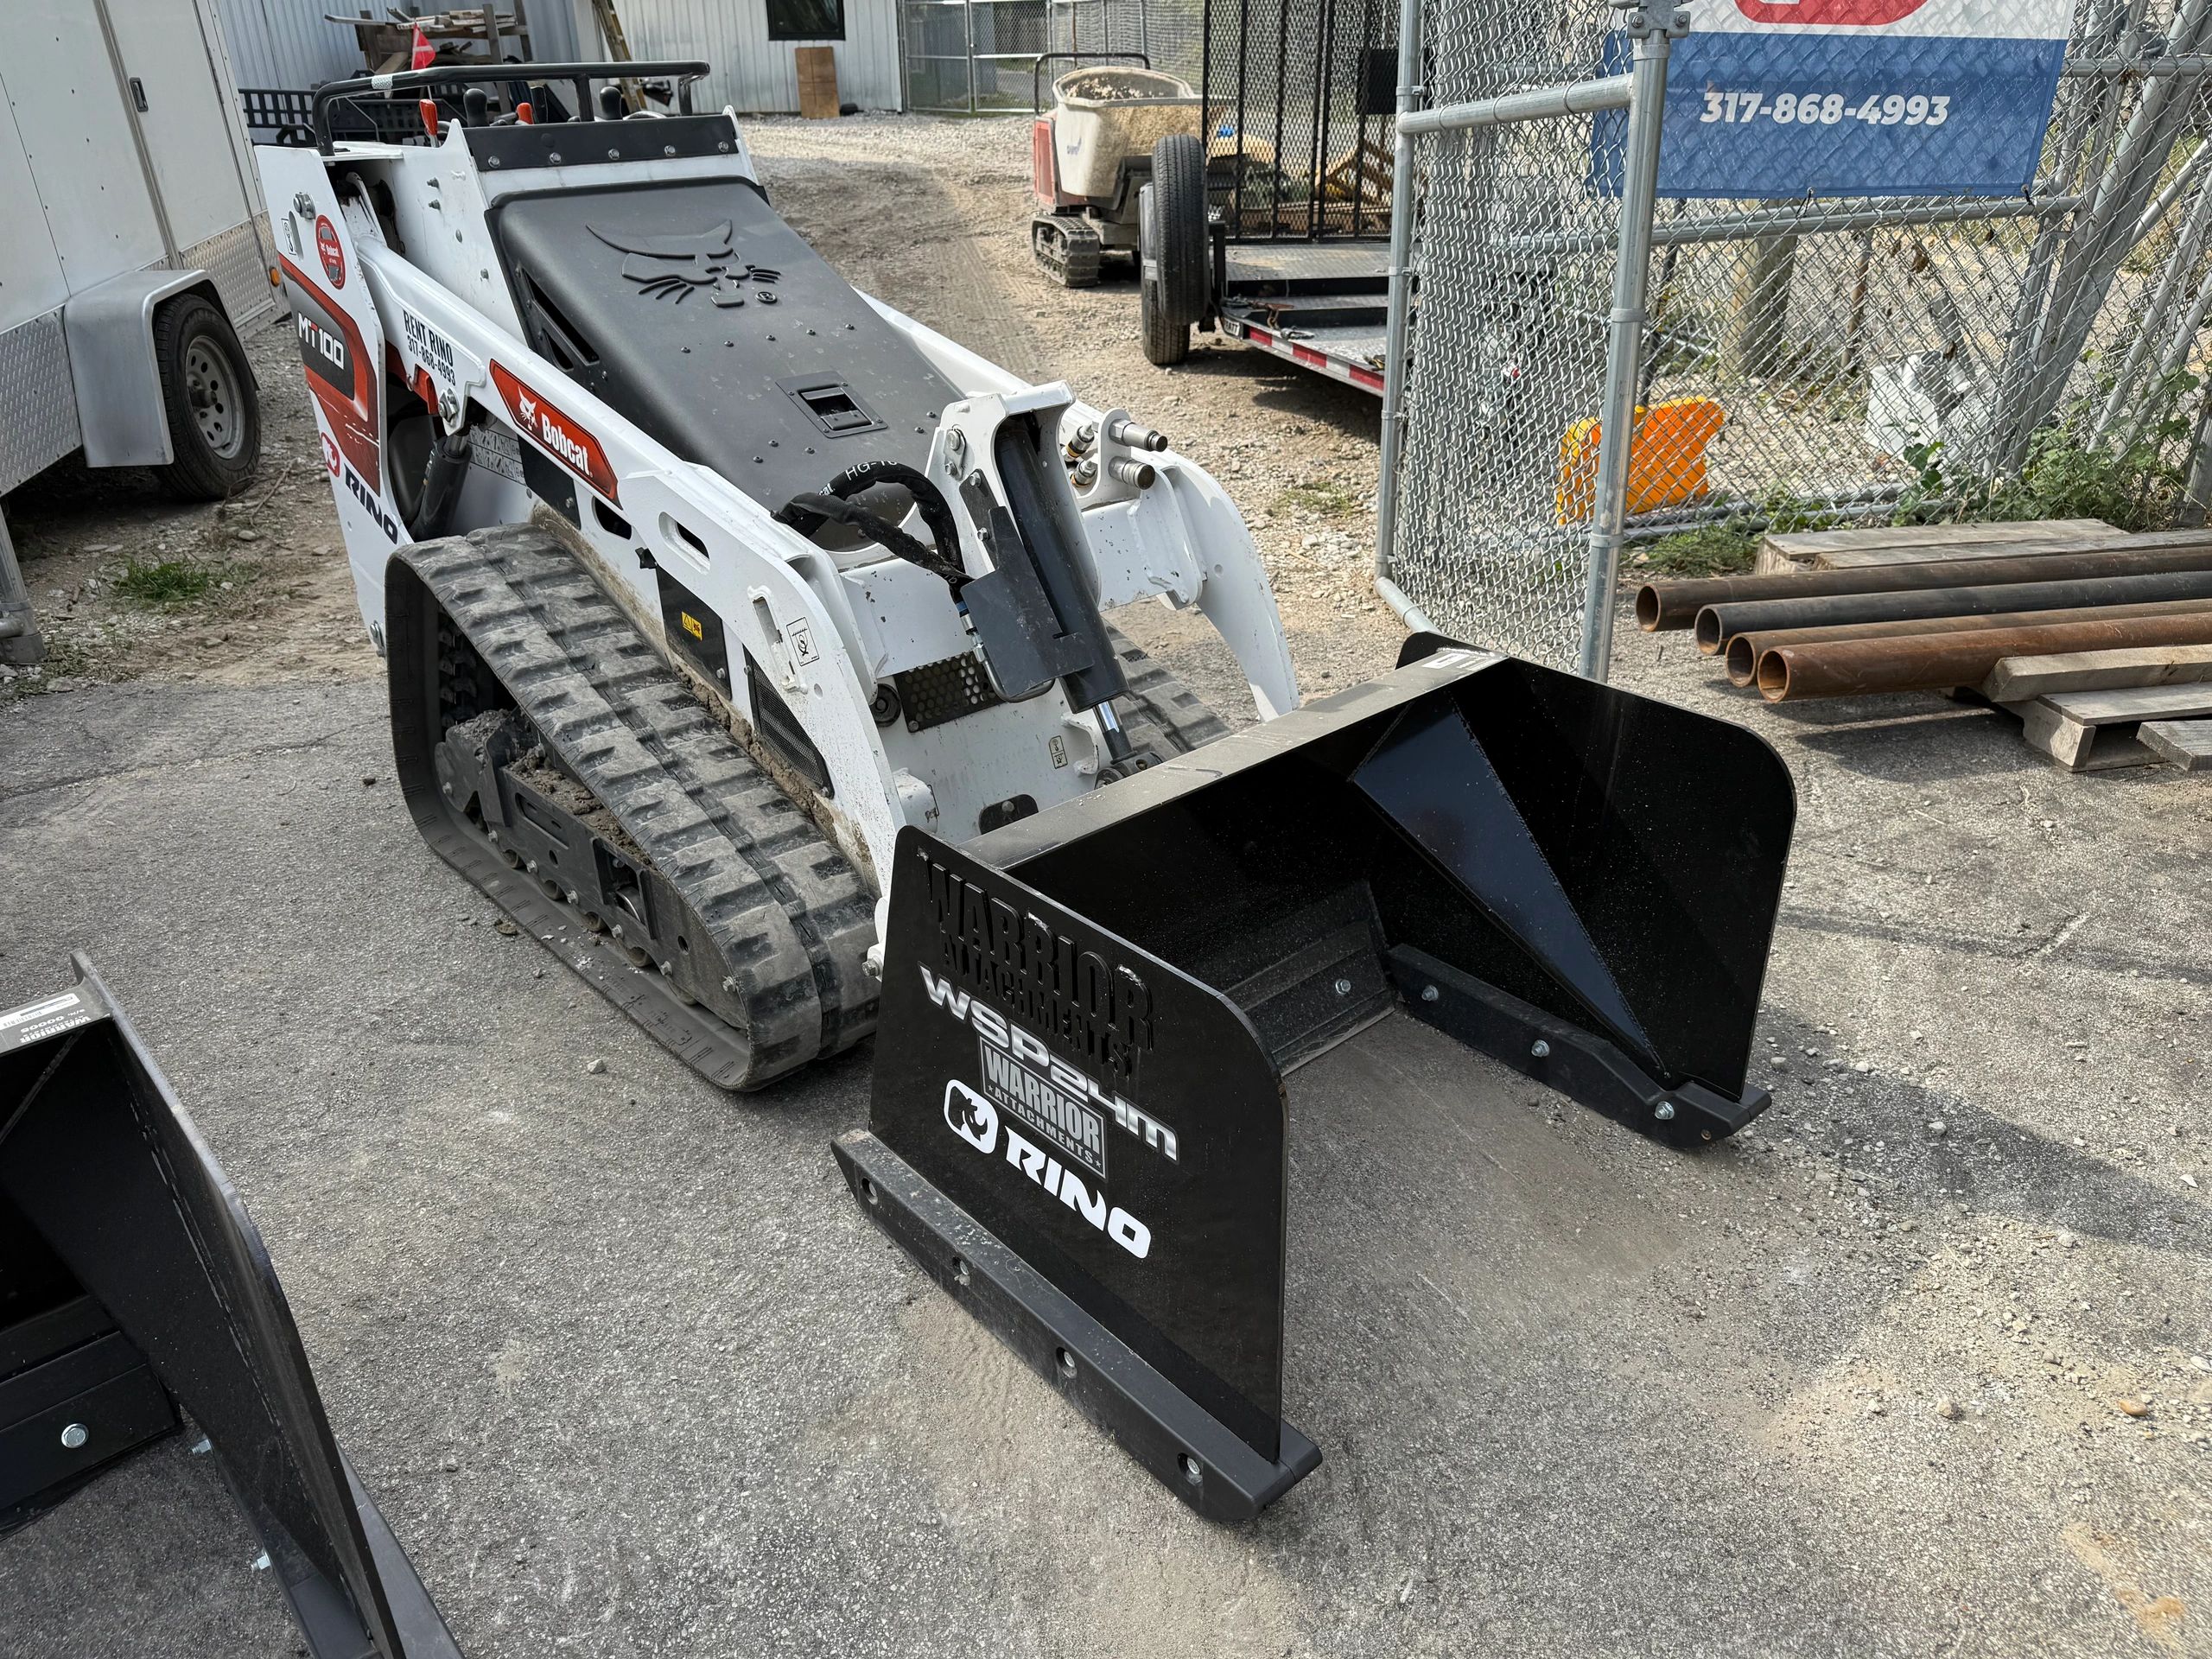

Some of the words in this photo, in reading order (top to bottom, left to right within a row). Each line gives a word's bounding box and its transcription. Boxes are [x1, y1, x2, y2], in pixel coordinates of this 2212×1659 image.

[1700, 92, 1951, 125] 317-868-4993
[404, 309, 426, 346] RENT
[429, 328, 453, 367] RINO
[407, 334, 455, 386] 317-868-4993
[541, 412, 591, 476] Bobcat
[344, 462, 397, 544] RINO
[984, 1045, 1101, 1155] WARRIOR
[995, 1087, 1094, 1165] ATTACHMENTS
[1005, 1125, 1152, 1259] RINO
